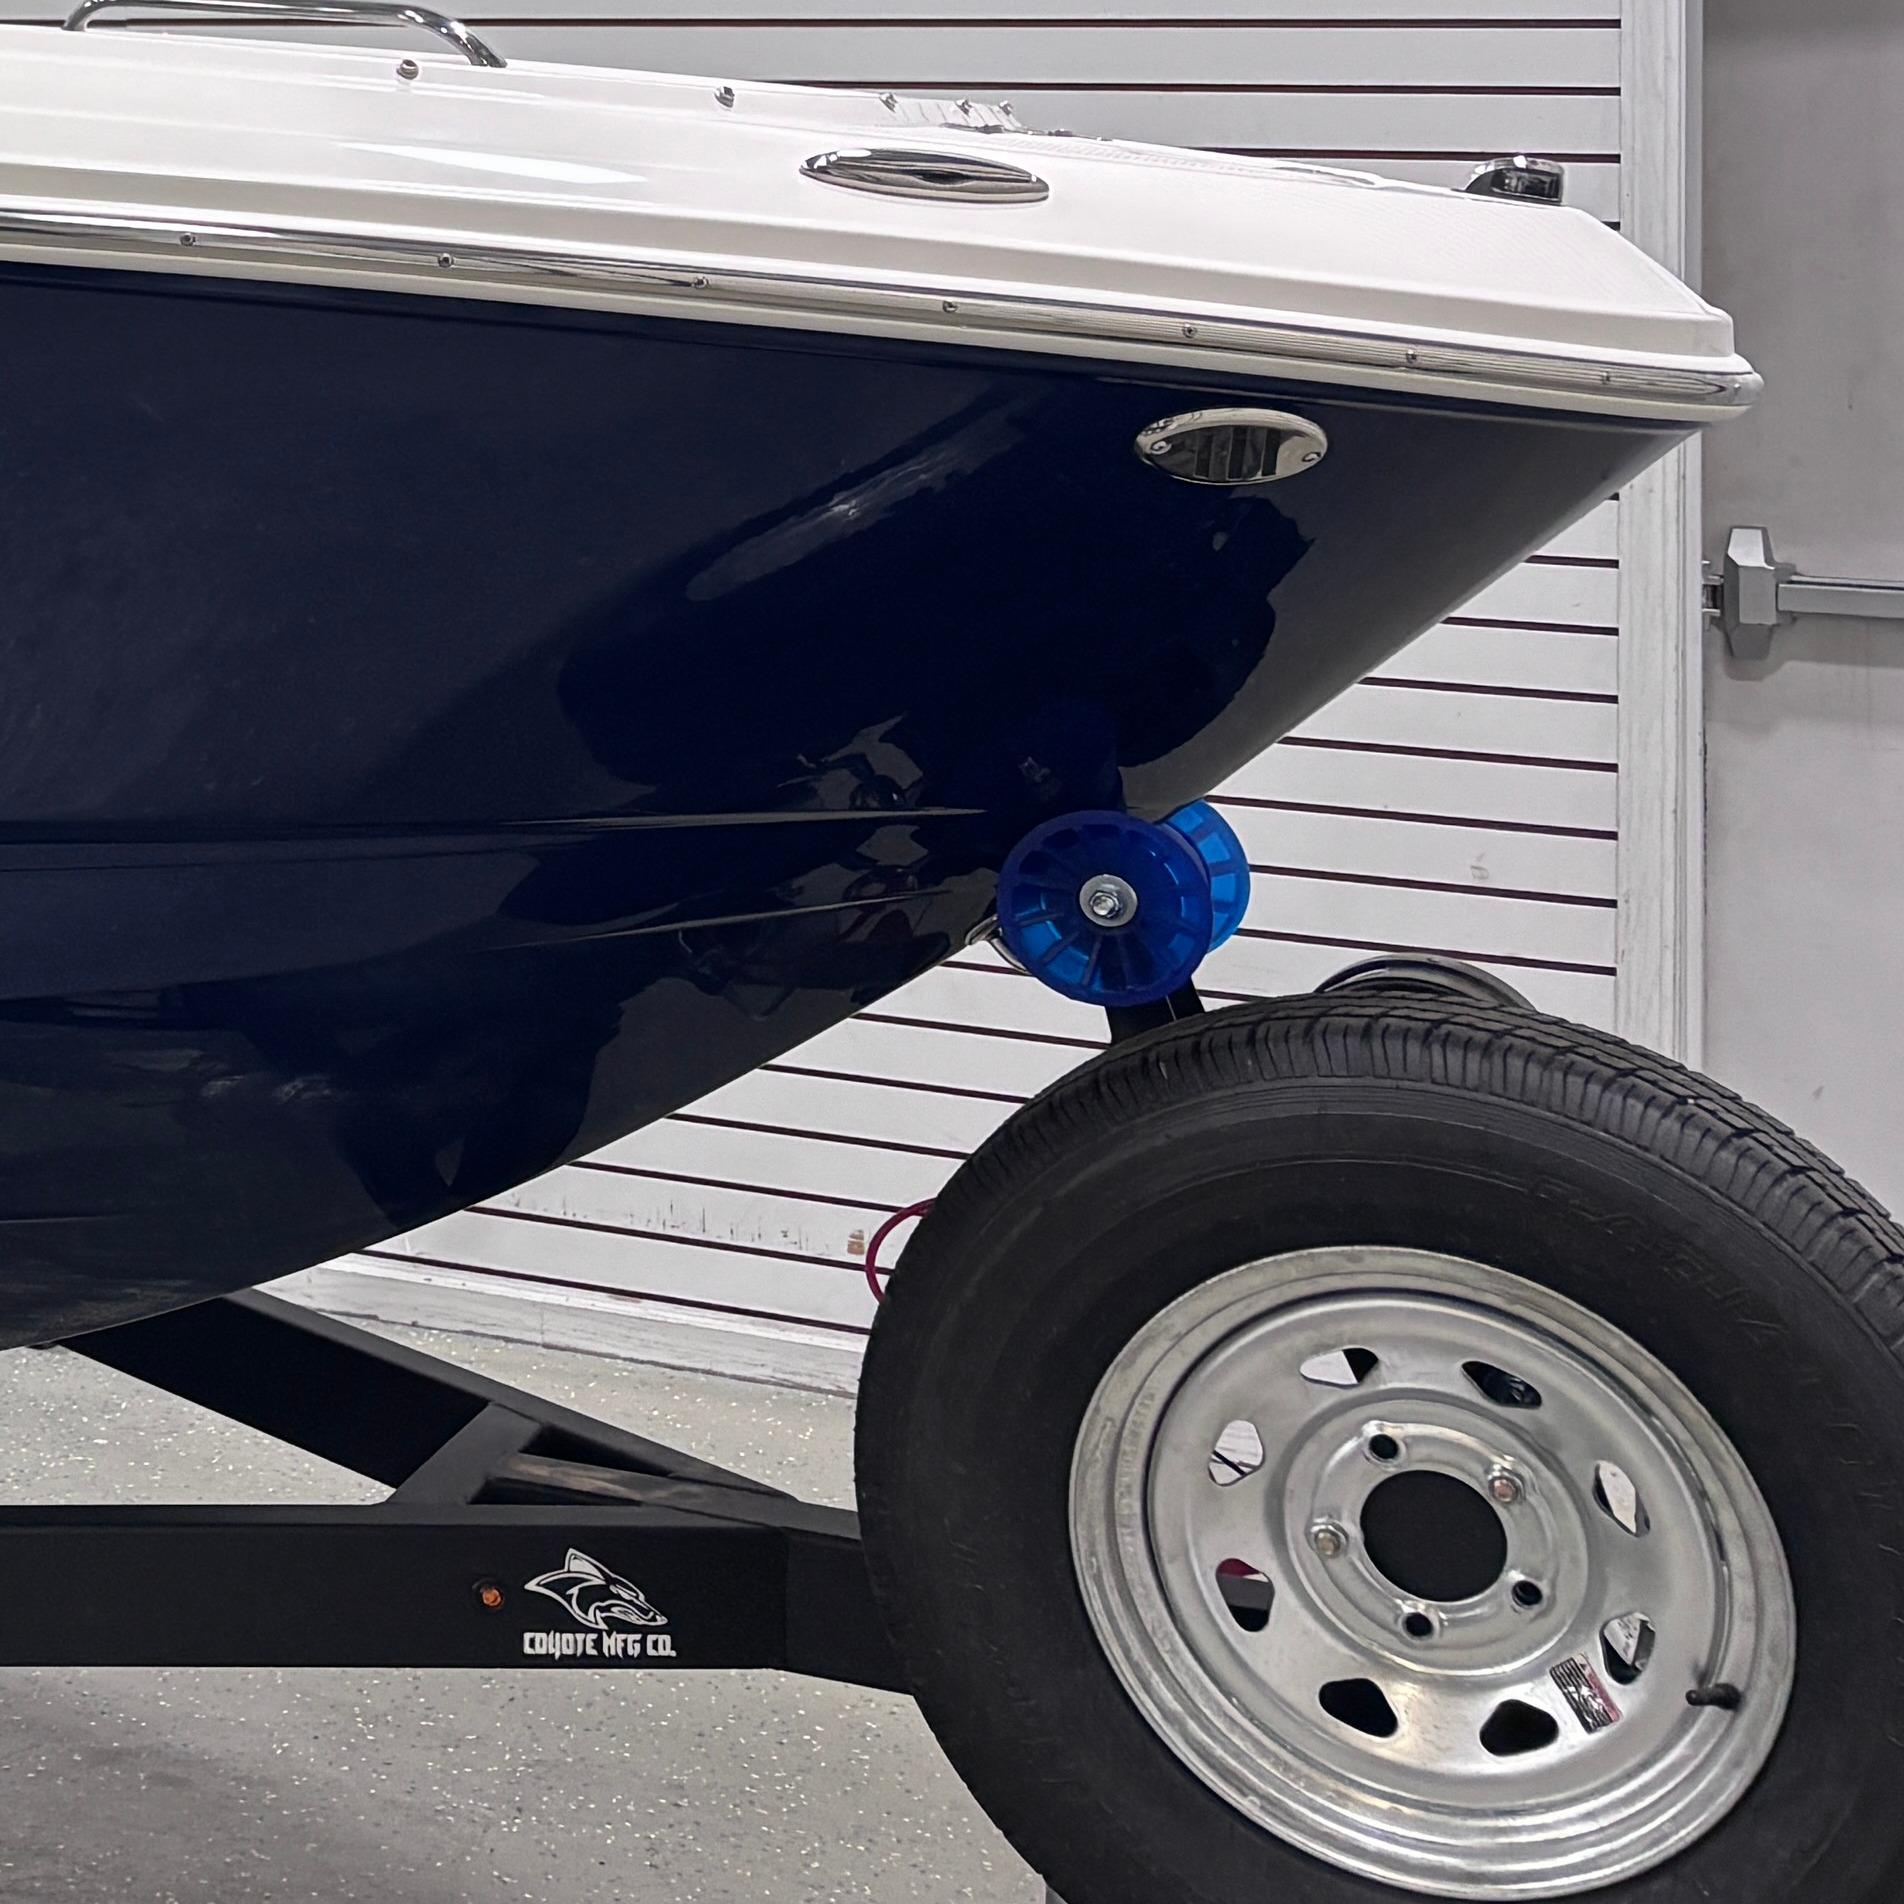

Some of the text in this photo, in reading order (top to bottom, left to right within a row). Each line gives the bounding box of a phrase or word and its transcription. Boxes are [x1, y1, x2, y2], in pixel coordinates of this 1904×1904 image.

[523, 1630, 677, 1660] COYOTE MFG CO.
